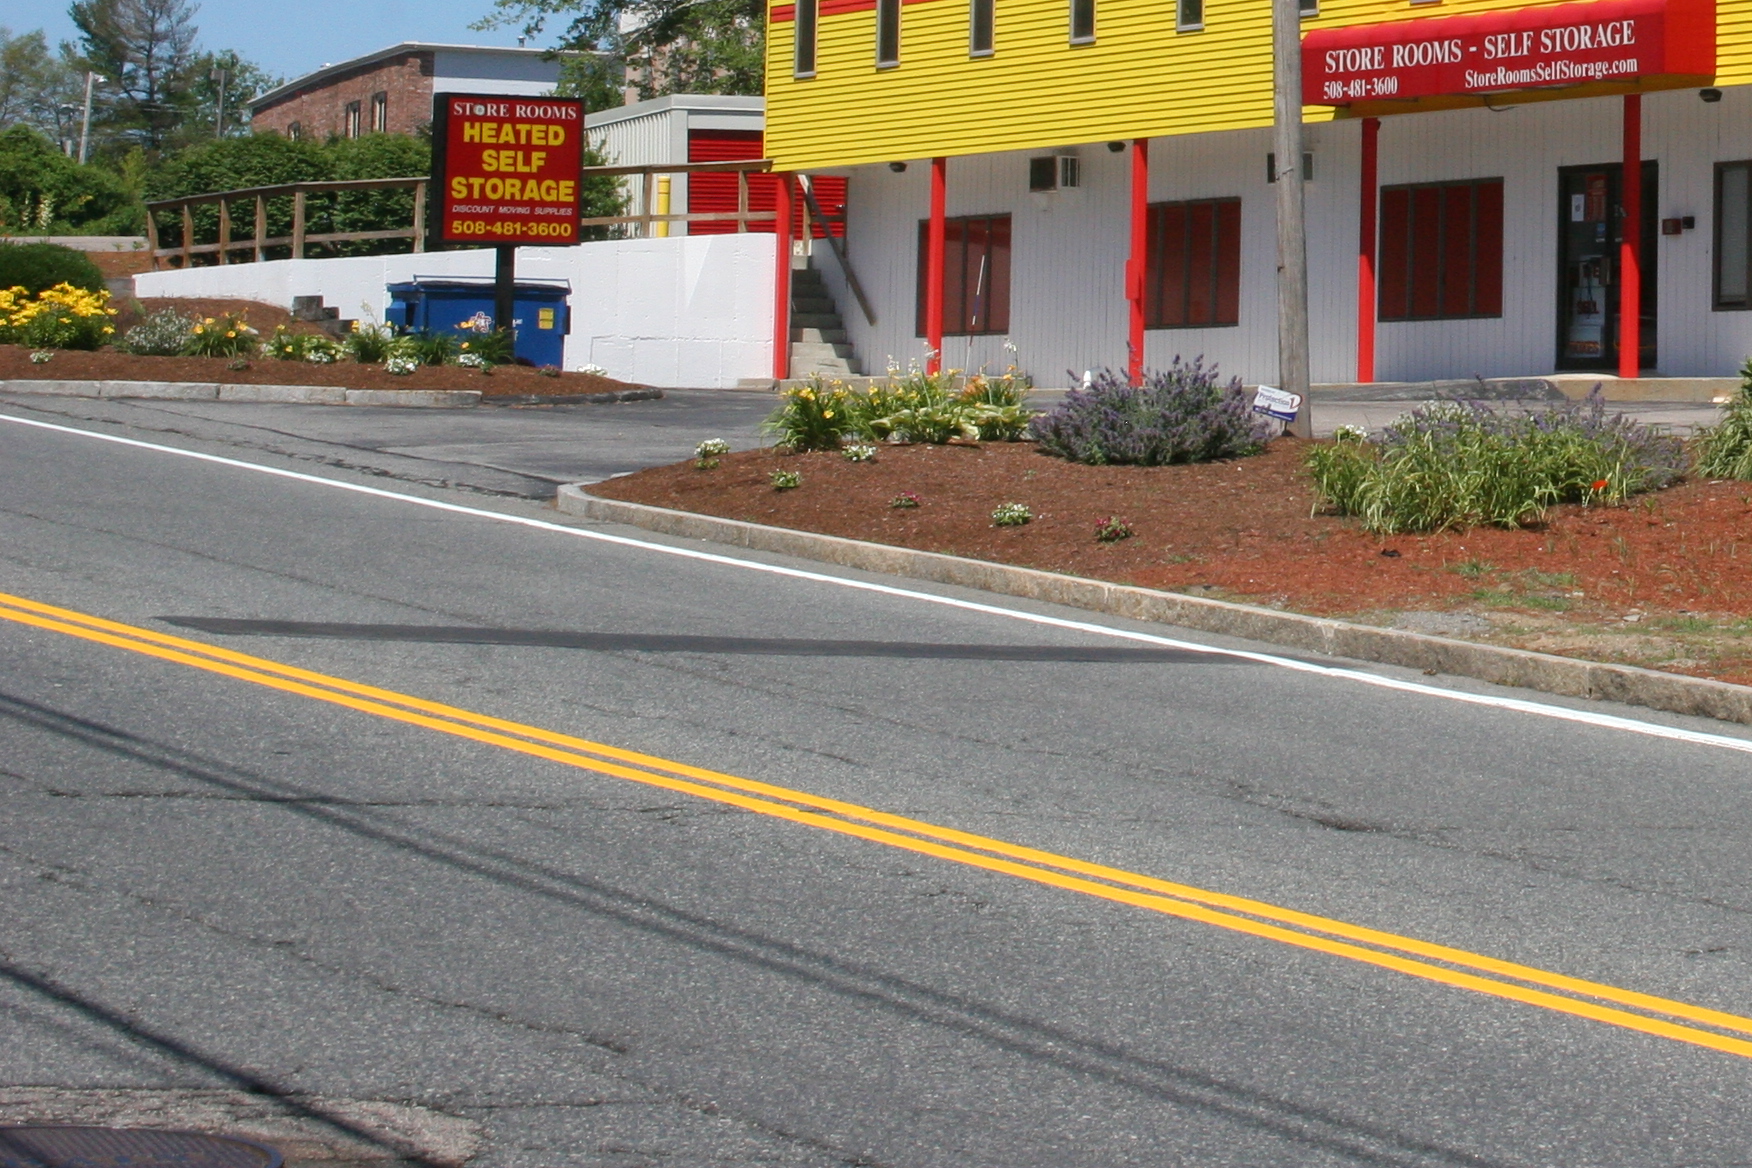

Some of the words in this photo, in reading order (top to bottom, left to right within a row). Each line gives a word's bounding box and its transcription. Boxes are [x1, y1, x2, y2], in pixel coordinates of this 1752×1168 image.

[1325, 46, 1385, 73] STORE
[1392, 39, 1462, 68] ROOMS
[1484, 32, 1534, 59] SELF
[1541, 20, 1635, 54] STORAGE
[1465, 58, 1638, 88] StoreRoomsSelfStorage.com
[1323, 76, 1398, 100] 508-481-3600
[454, 102, 509, 117] STORE
[516, 105, 576, 120] ROOMS
[463, 122, 565, 146] HEATED
[482, 149, 546, 172] SELF
[451, 176, 575, 202] STORAGE
[452, 205, 495, 213] DISCOUNT
[452, 221, 571, 236] 508-481-3600
